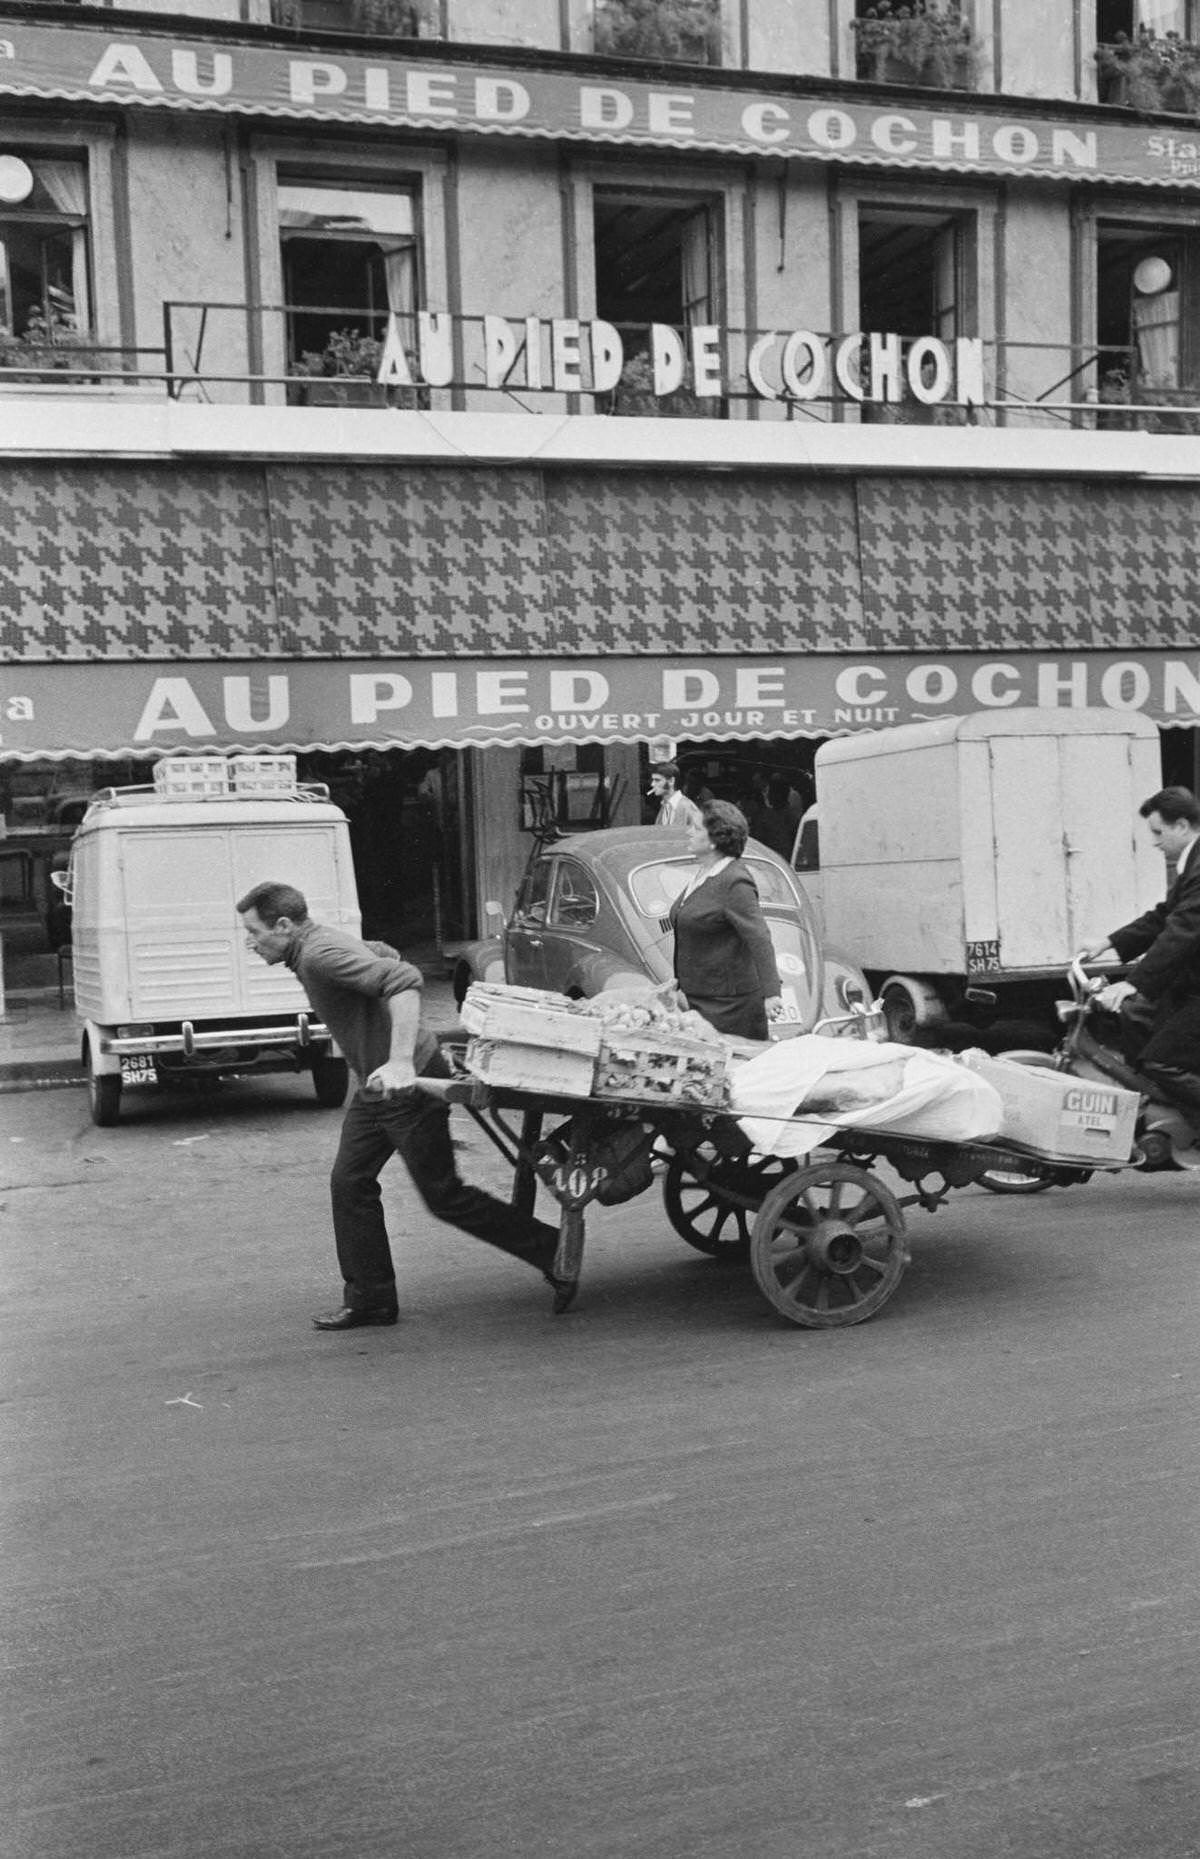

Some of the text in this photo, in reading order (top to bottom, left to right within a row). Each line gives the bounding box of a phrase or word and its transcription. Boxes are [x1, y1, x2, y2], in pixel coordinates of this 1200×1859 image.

[89, 43, 1098, 169] AU PIED DE COCHON
[377, 311, 985, 404] AU PIED DE COCHON
[134, 660, 1200, 742] AU PIED DE COCHON
[535, 706, 901, 731] OUVERT JOUR ET NUIT
[968, 942, 997, 957] 7614
[969, 957, 999, 972] SH75
[121, 1055, 154, 1070] 2681
[121, 1068, 158, 1084] SH75
[1067, 1091, 1114, 1114] GUIN
